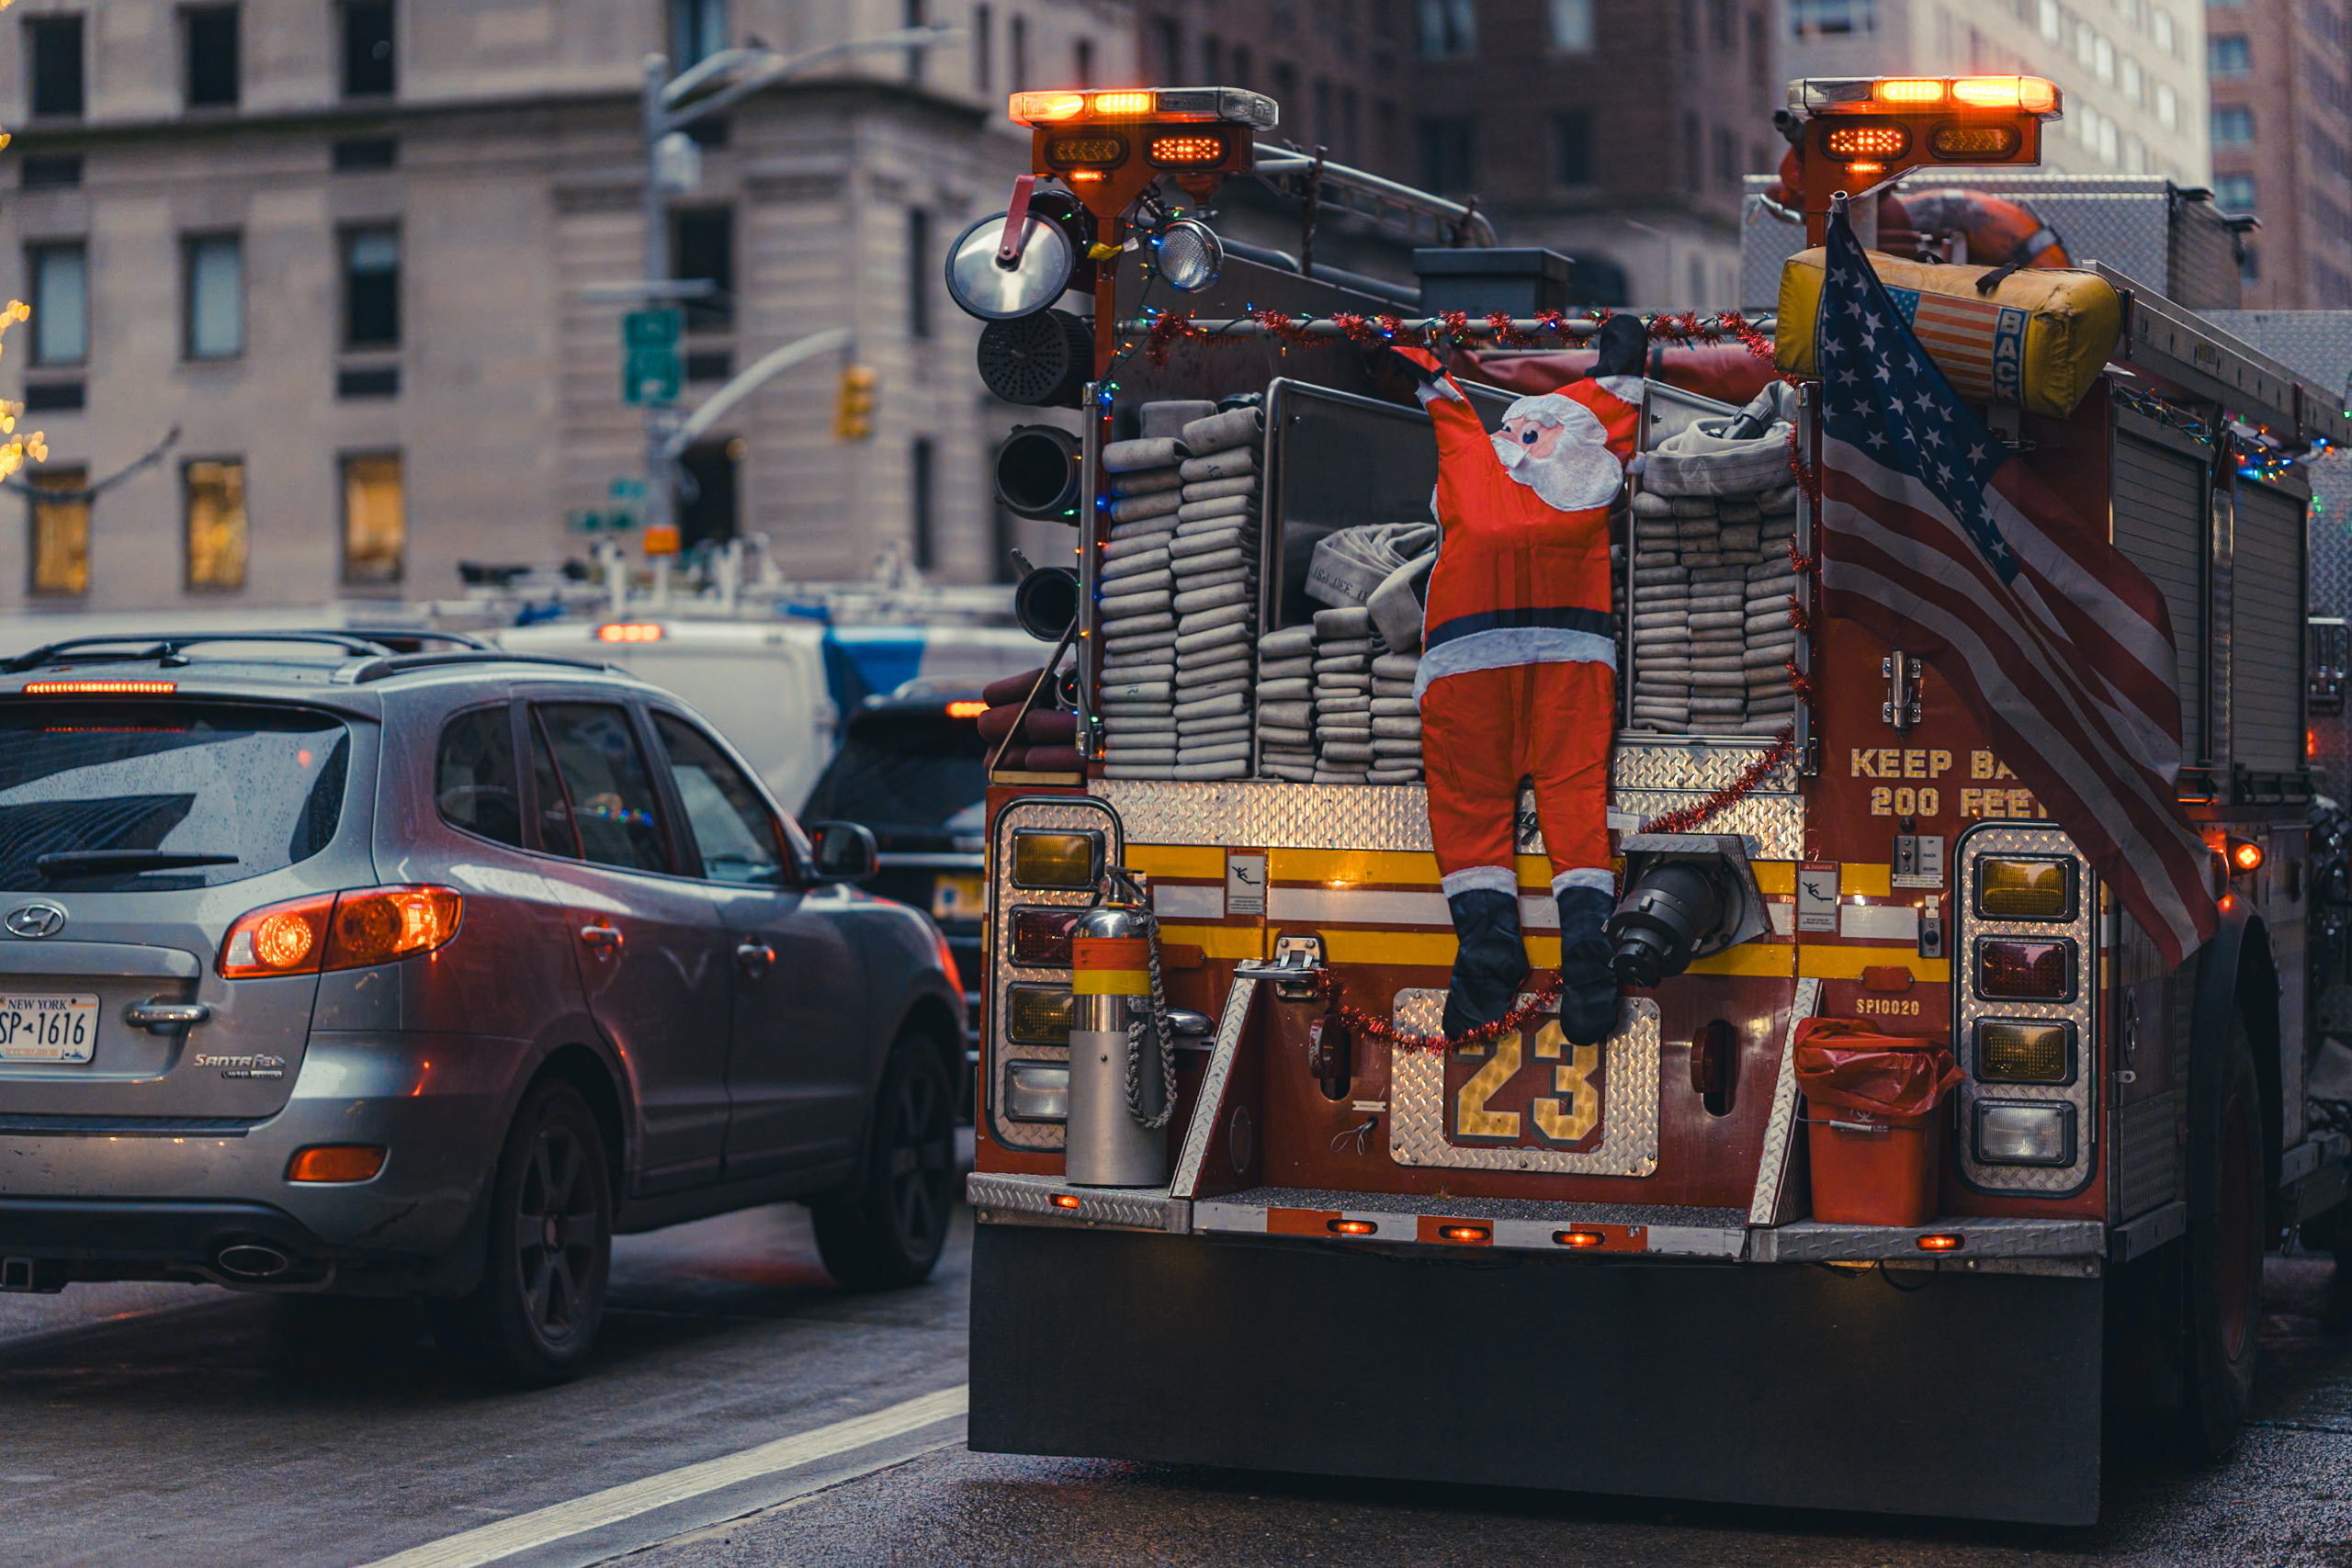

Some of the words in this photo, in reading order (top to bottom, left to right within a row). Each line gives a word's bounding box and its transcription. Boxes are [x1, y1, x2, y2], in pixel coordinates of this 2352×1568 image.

[1995, 311, 2022, 402] BACK
[1850, 748, 1952, 779] KEEP
[1971, 750, 2019, 780] BA
[1871, 786, 1939, 817] 200
[7, 998, 35, 1010] NEW
[38, 998, 67, 1010] YORK
[1856, 998, 1919, 1015] SP10020
[1454, 1018, 1600, 1141] 23
